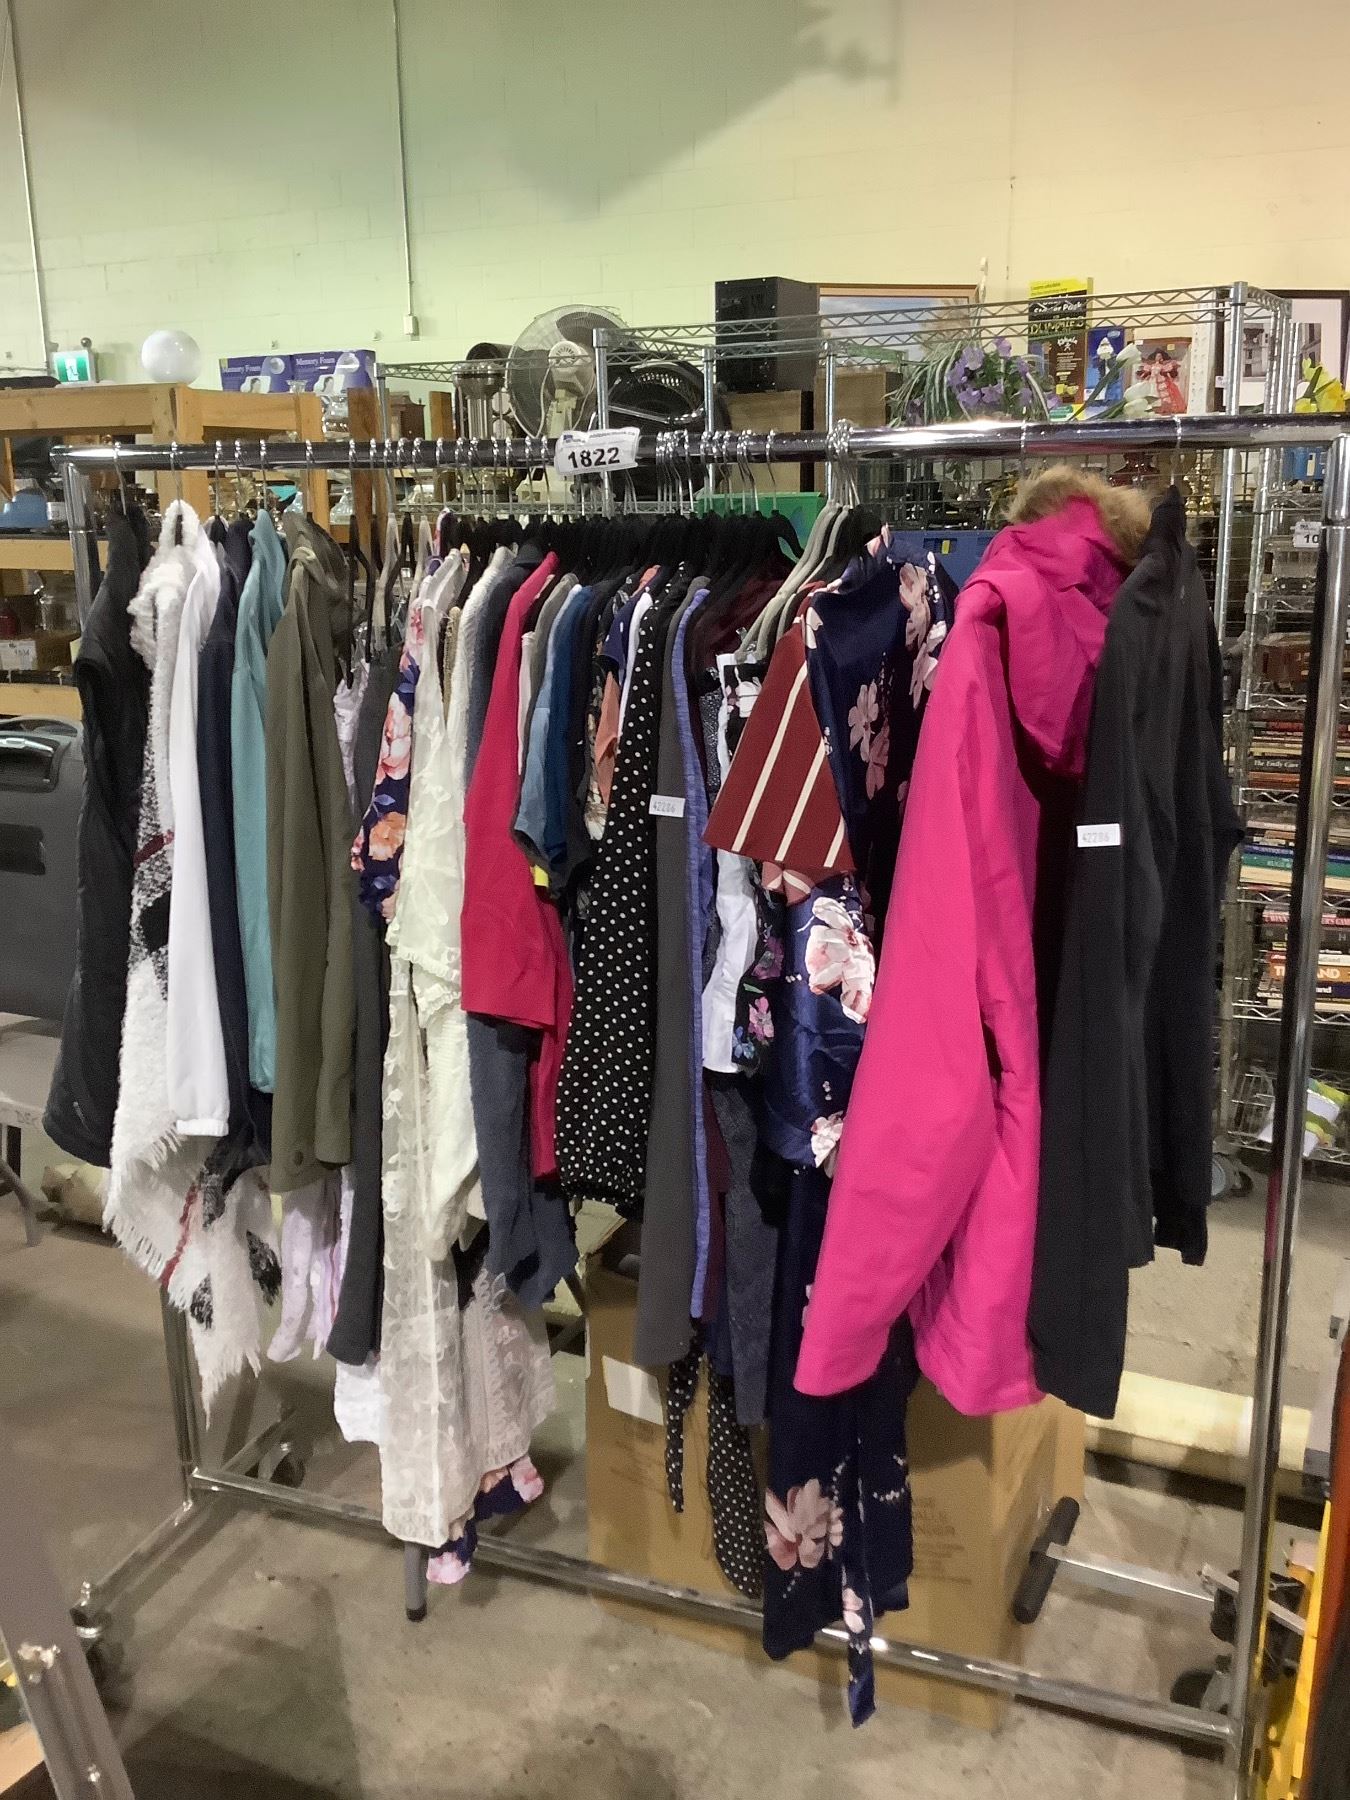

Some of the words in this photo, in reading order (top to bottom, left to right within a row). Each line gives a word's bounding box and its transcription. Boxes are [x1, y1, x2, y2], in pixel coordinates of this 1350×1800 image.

[296, 358, 318, 366] Memory
[222, 366, 245, 374] Memory
[568, 447, 620, 469] 1822
[1266, 760, 1282, 768] Emily
